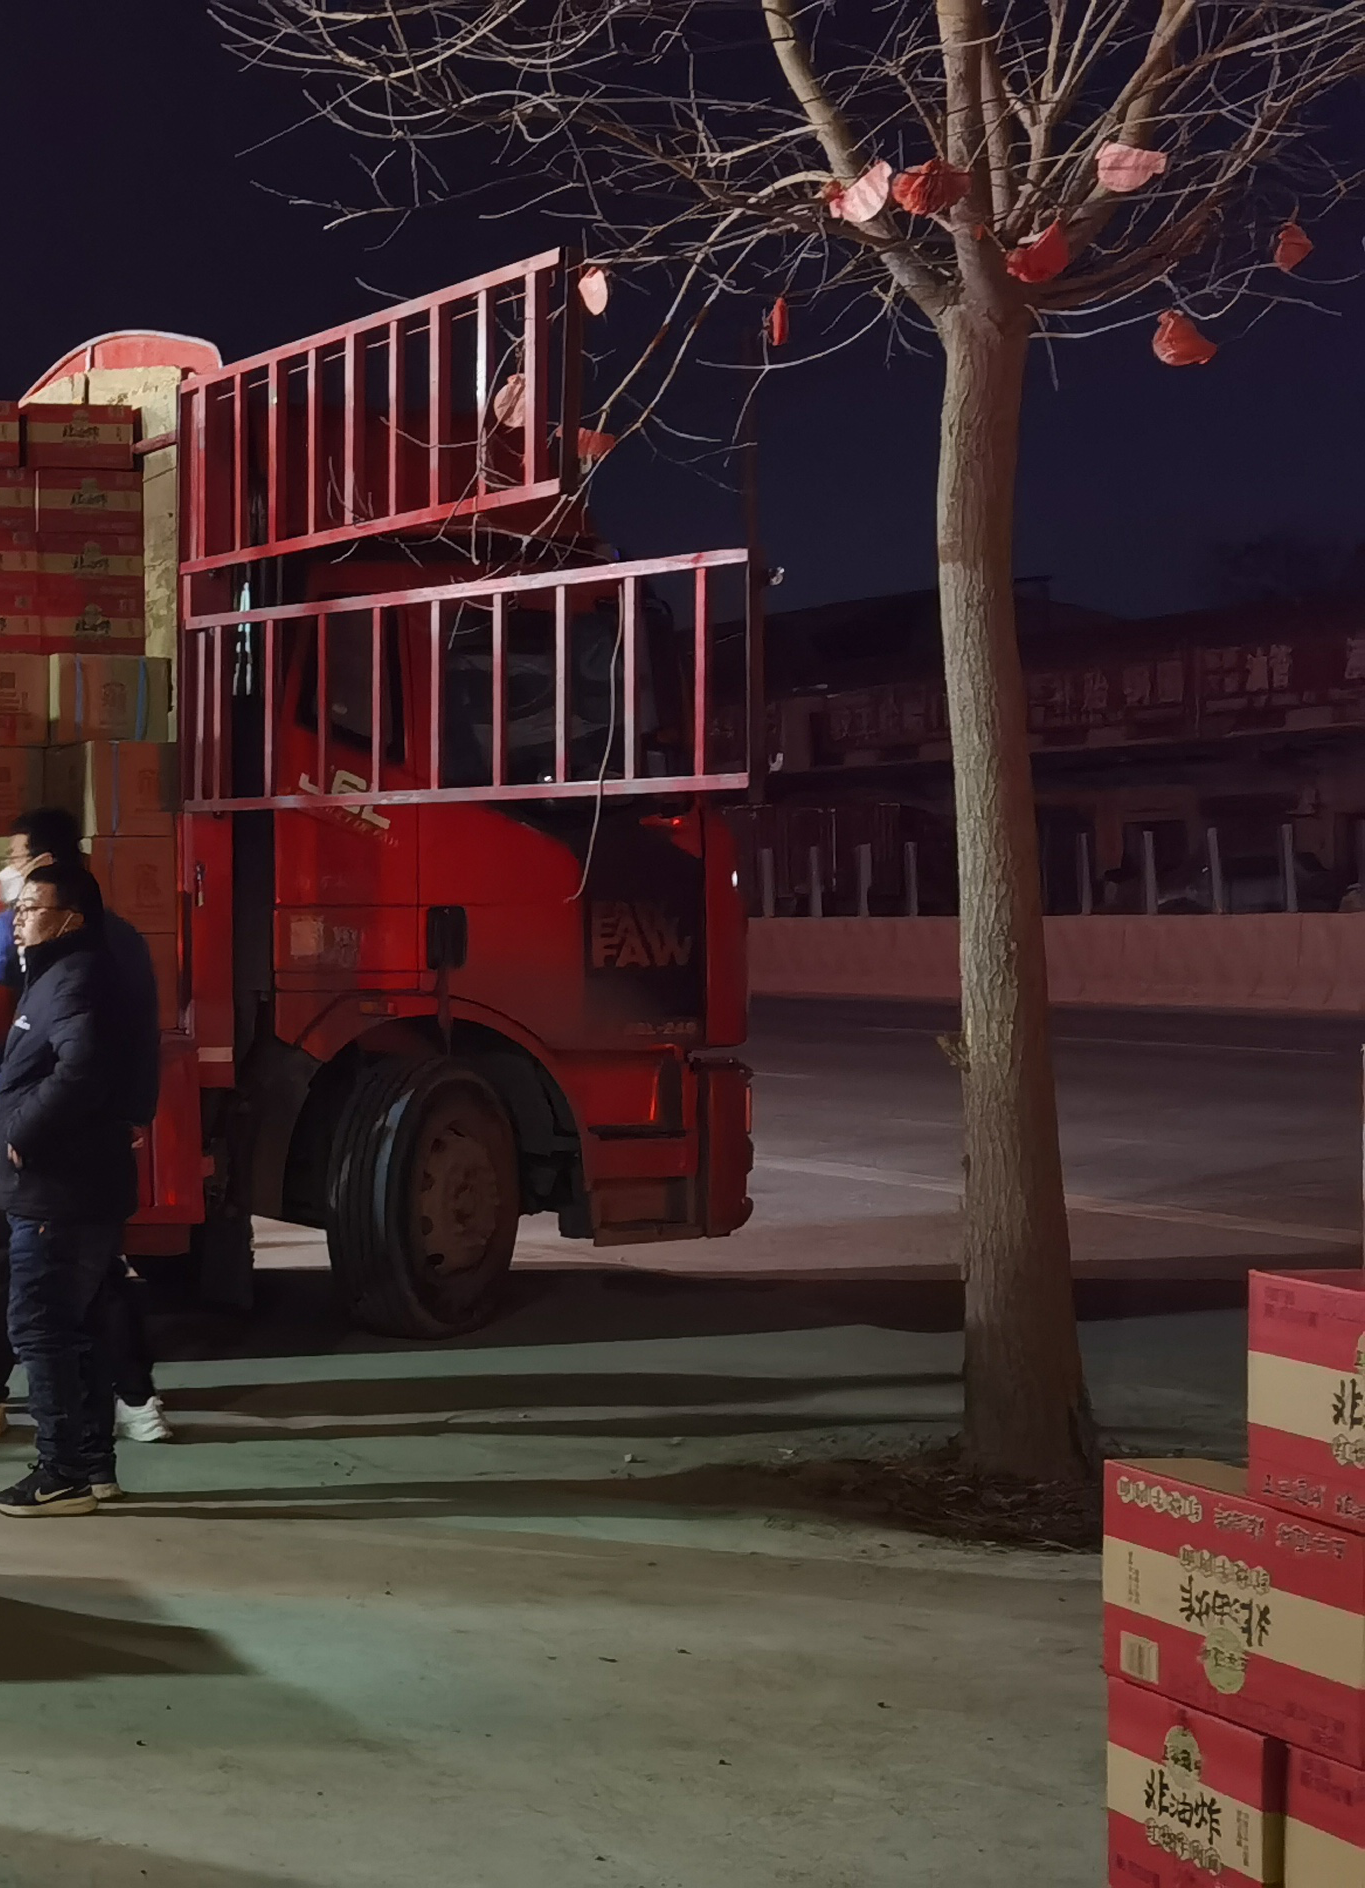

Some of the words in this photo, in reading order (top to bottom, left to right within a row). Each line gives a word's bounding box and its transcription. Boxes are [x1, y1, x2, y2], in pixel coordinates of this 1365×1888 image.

[1178, 1573, 1272, 1648] 非油炸
[1143, 1768, 1222, 1846] 非油炸
